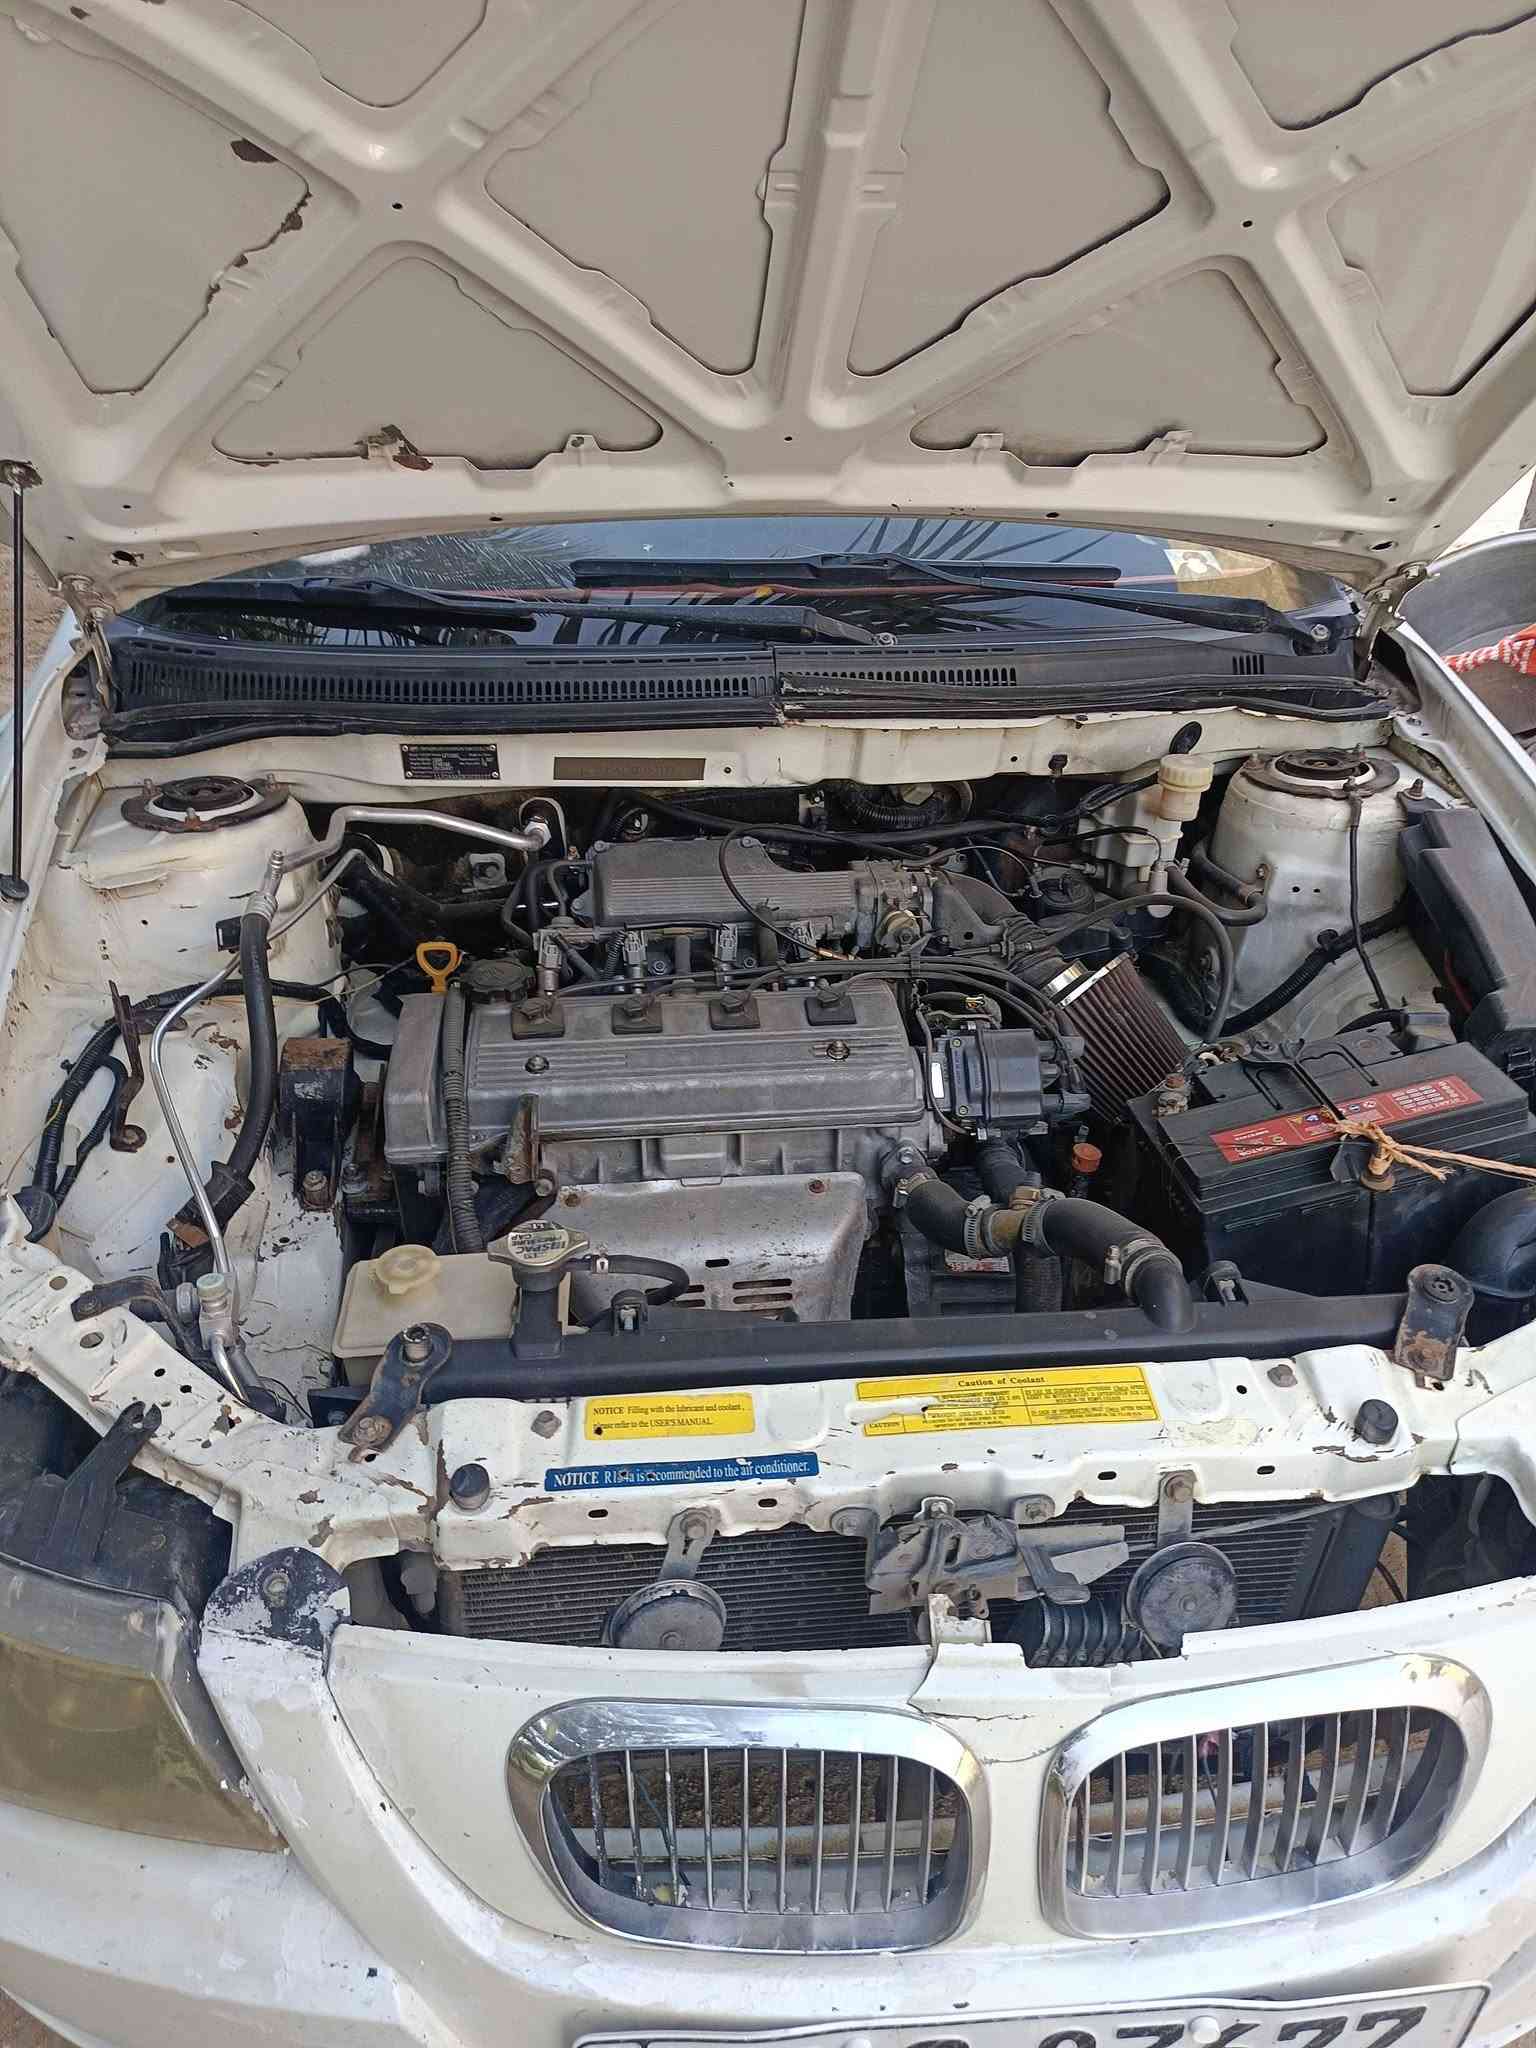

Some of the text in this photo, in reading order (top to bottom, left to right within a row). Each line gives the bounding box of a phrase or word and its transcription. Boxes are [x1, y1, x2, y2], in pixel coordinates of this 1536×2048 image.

[958, 1376, 1046, 1387] Caution of Coolant
[593, 1406, 625, 1415] NOTICE
[665, 1404, 676, 1412] the
[705, 1403, 717, 1411] and
[631, 1420, 639, 1428] to
[639, 1419, 649, 1428] the
[553, 1471, 600, 1487] NOTICE
[635, 1468, 645, 1482] is
[713, 1466, 724, 1478] to
[724, 1464, 739, 1477] the
[740, 1463, 754, 1476] air
[755, 1459, 811, 1475] conditioner.
